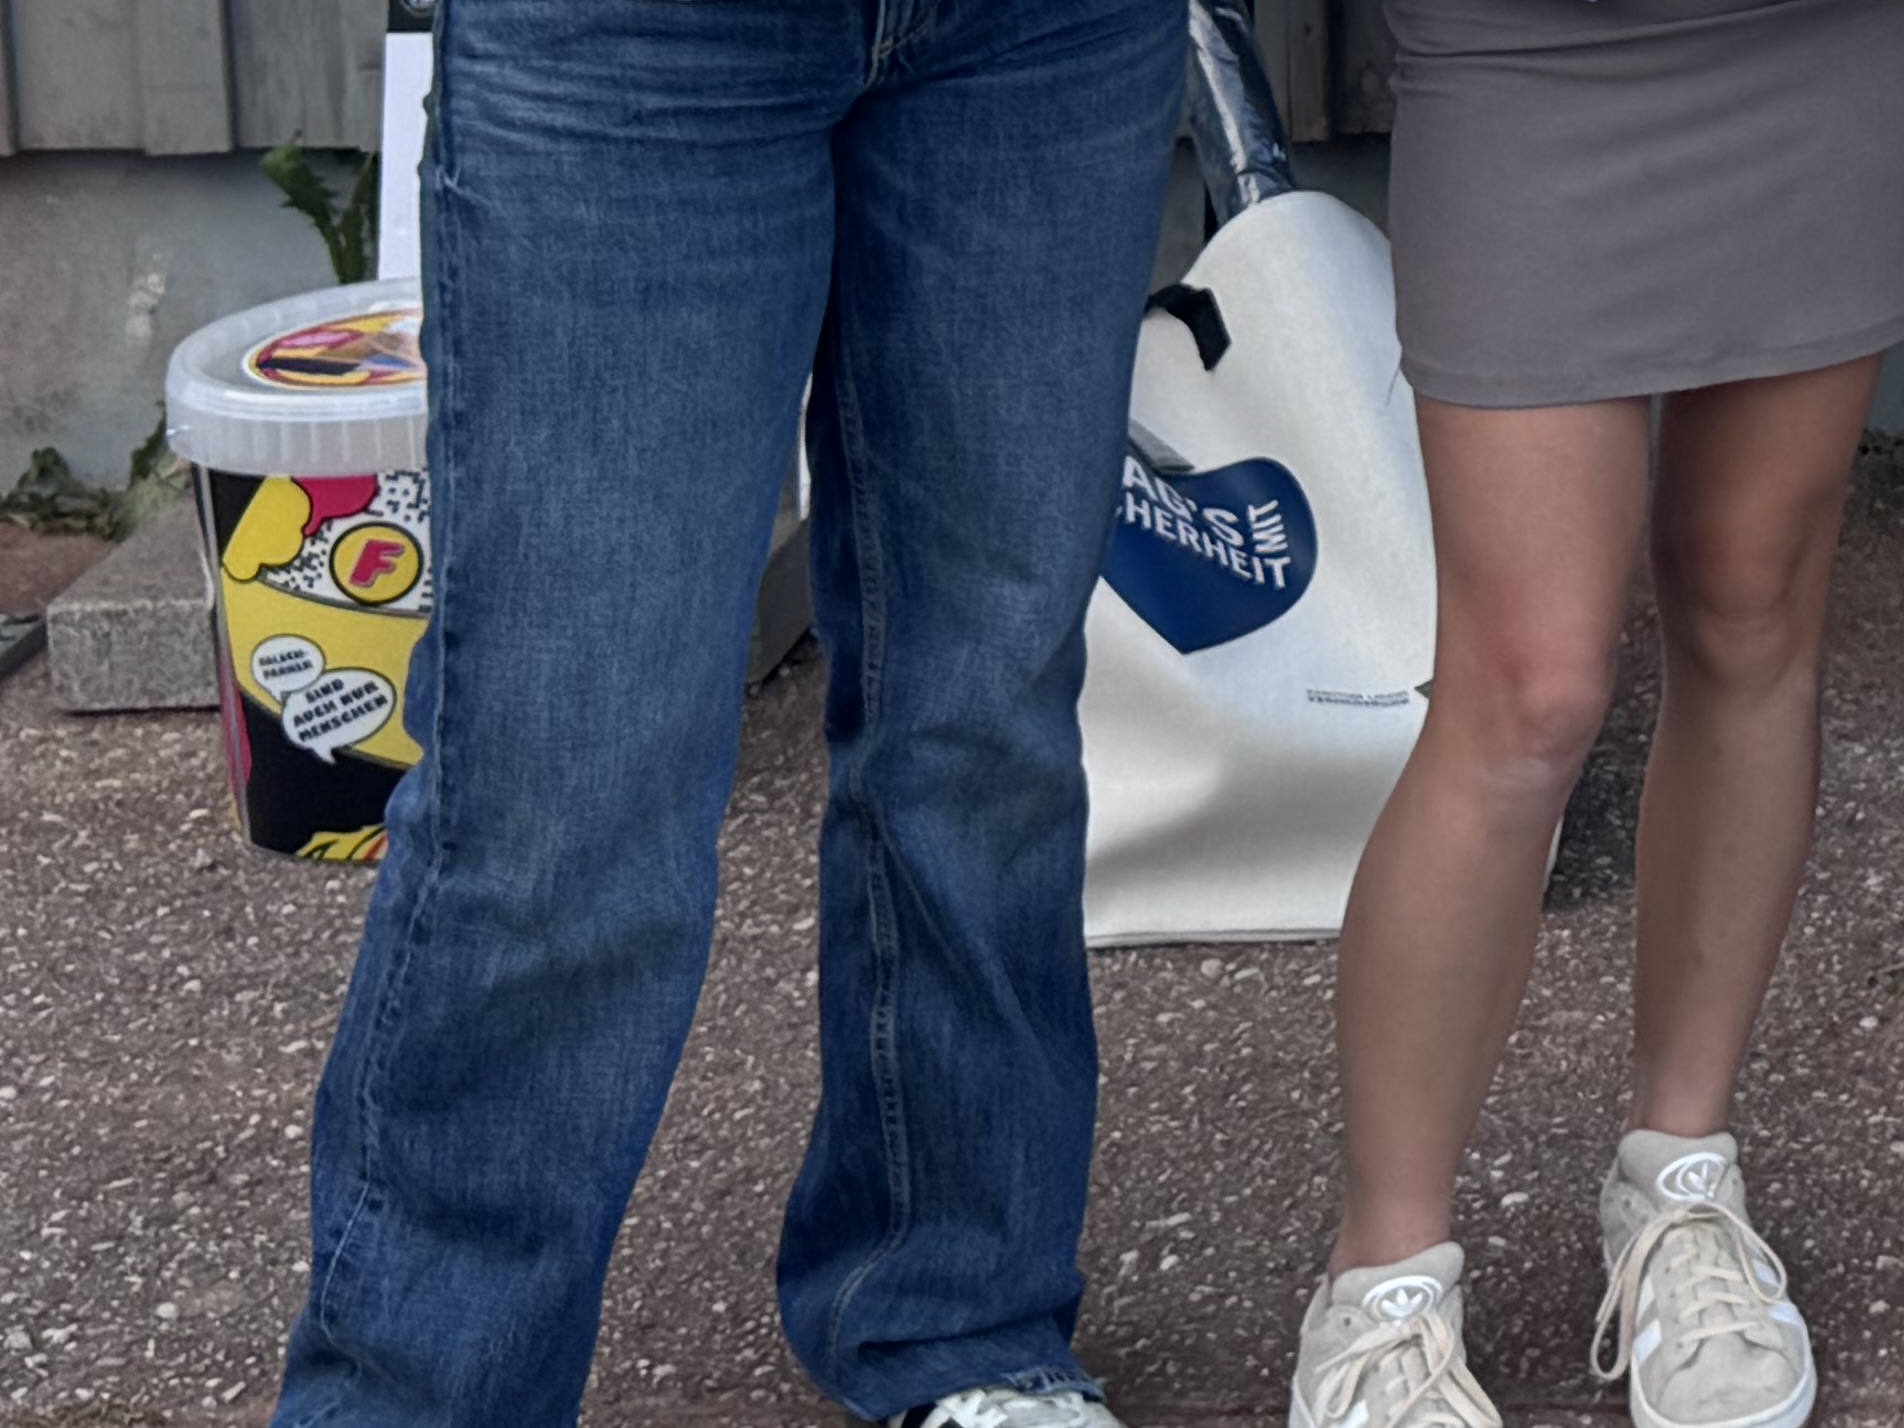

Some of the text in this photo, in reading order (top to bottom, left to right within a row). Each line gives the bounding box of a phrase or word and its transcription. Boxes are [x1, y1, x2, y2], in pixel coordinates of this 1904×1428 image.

[1121, 455, 1244, 548] AG'S
[348, 538, 405, 588] F
[1115, 492, 1291, 590] HERHEIT
[298, 694, 389, 743] MENSCHEN
